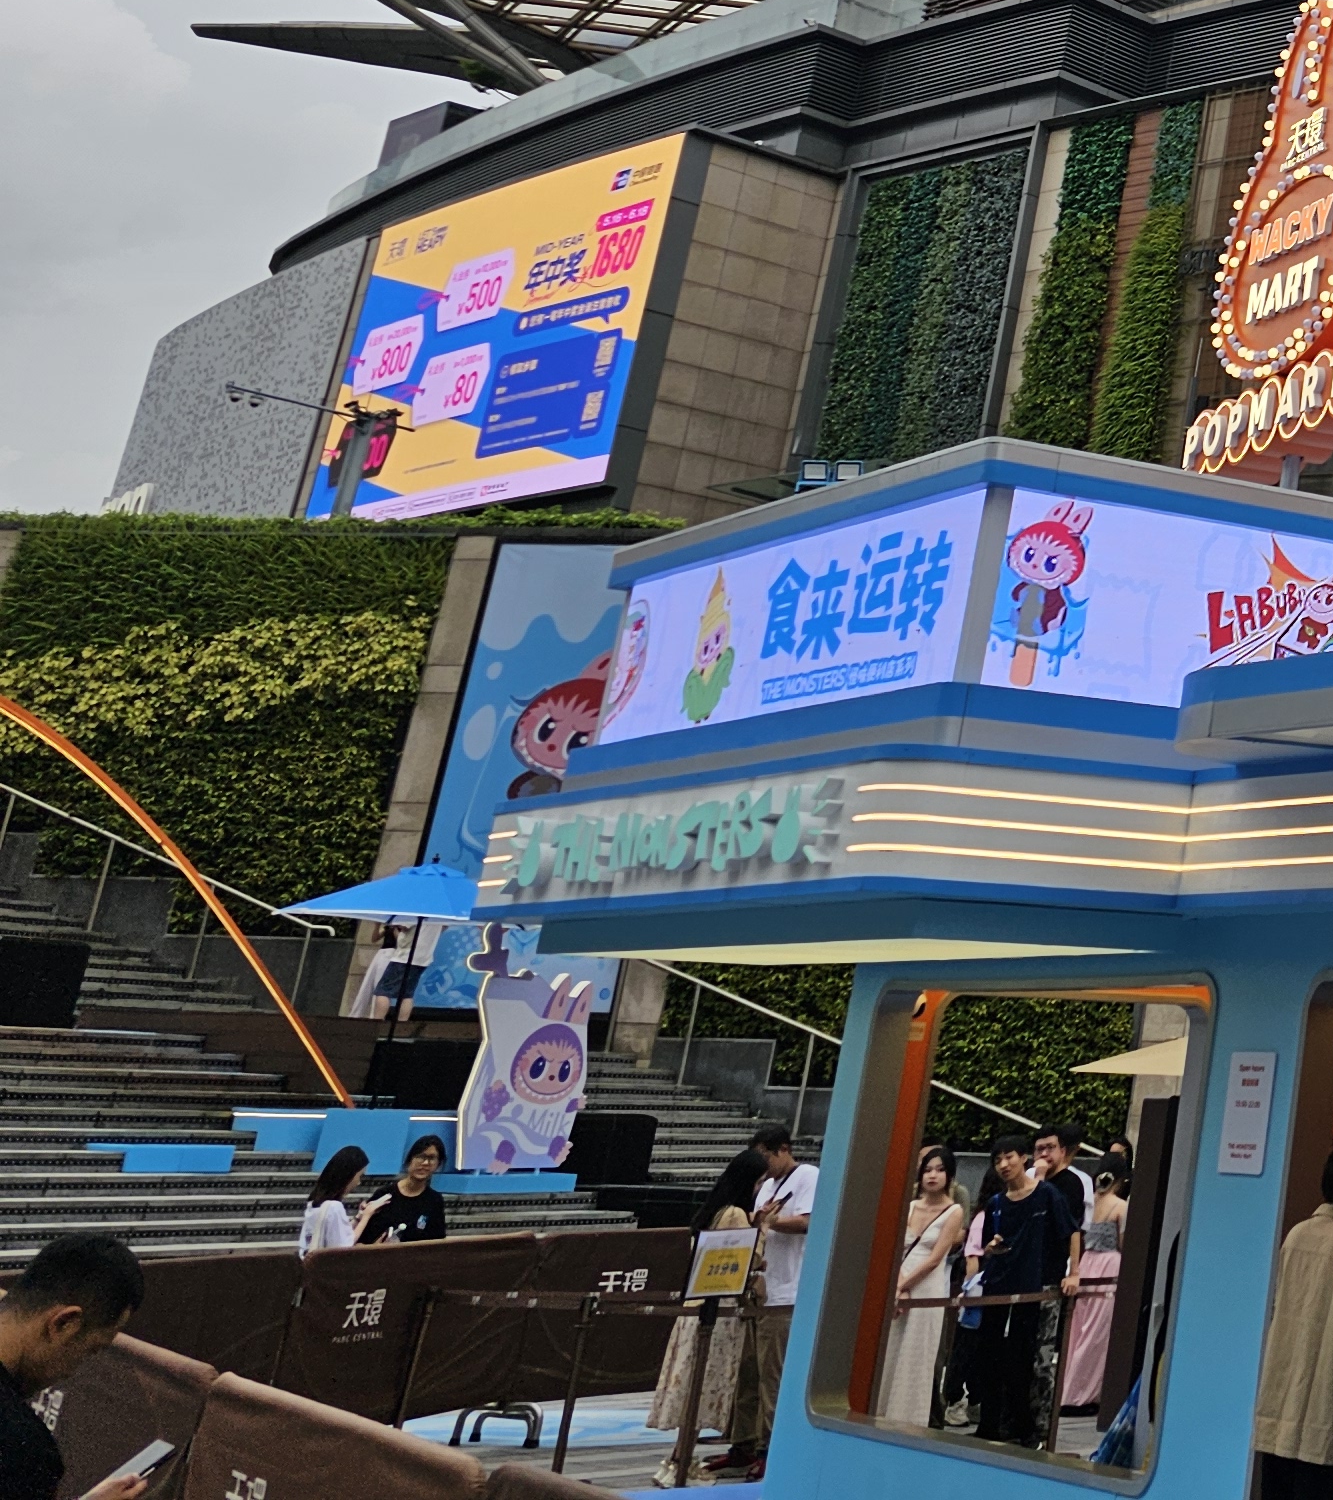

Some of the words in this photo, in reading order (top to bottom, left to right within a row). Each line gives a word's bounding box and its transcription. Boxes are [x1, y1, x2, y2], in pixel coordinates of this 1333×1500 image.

[534, 233, 585, 257] MID-YEAR
[457, 275, 502, 316] ¥500
[1245, 254, 1322, 325] MART
[371, 341, 412, 381] ¥800
[444, 370, 478, 409] ¥80
[760, 530, 954, 661] 食来运转
[762, 678, 784, 704] THE
[783, 664, 848, 698] MONSTERS
[552, 814, 604, 882] THE
[609, 786, 773, 872] MONSTERS
[527, 1108, 571, 1139] Milk
[342, 1288, 387, 1329] 天環
[352, 1330, 384, 1343] CENTRAL
